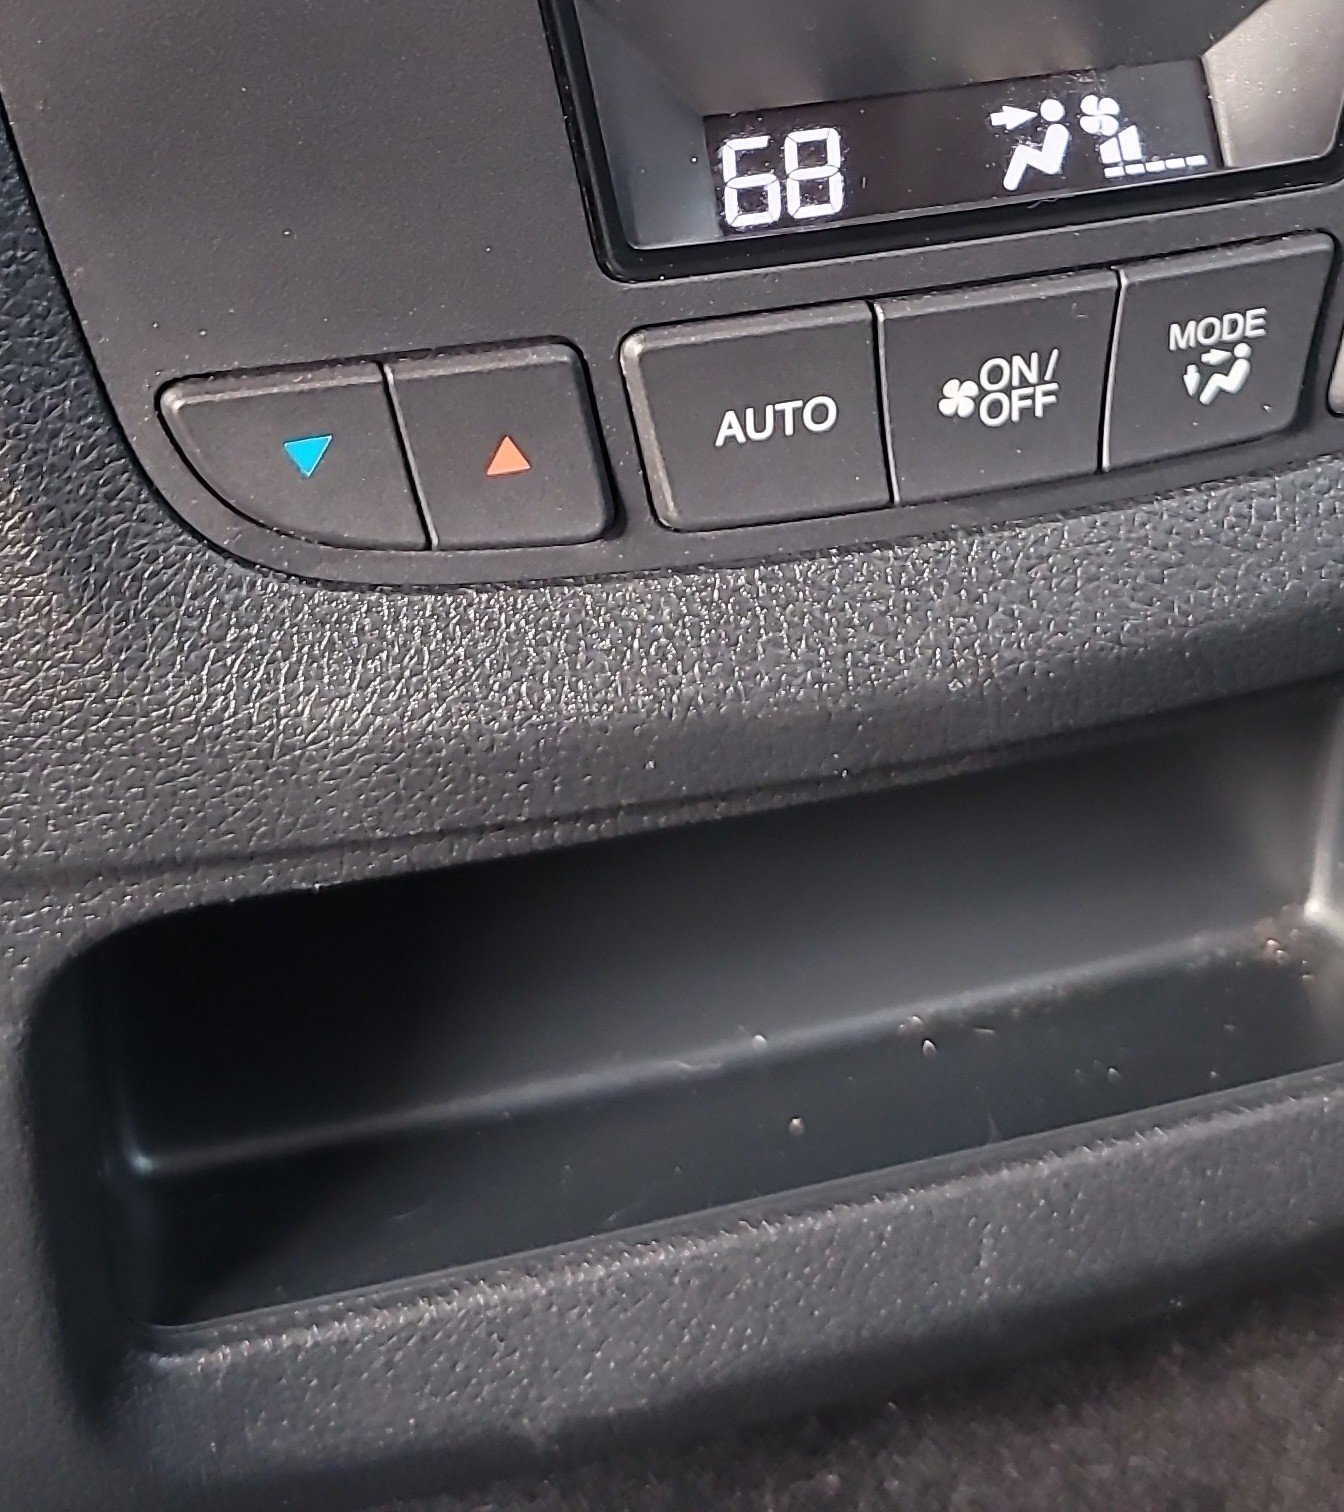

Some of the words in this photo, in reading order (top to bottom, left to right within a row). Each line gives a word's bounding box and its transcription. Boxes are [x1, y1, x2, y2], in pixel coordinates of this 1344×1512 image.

[719, 126, 845, 230] 68
[1168, 307, 1268, 352] MODE
[979, 348, 1059, 391] ON/
[714, 395, 838, 448] AUTO
[979, 382, 1059, 428] OFF
